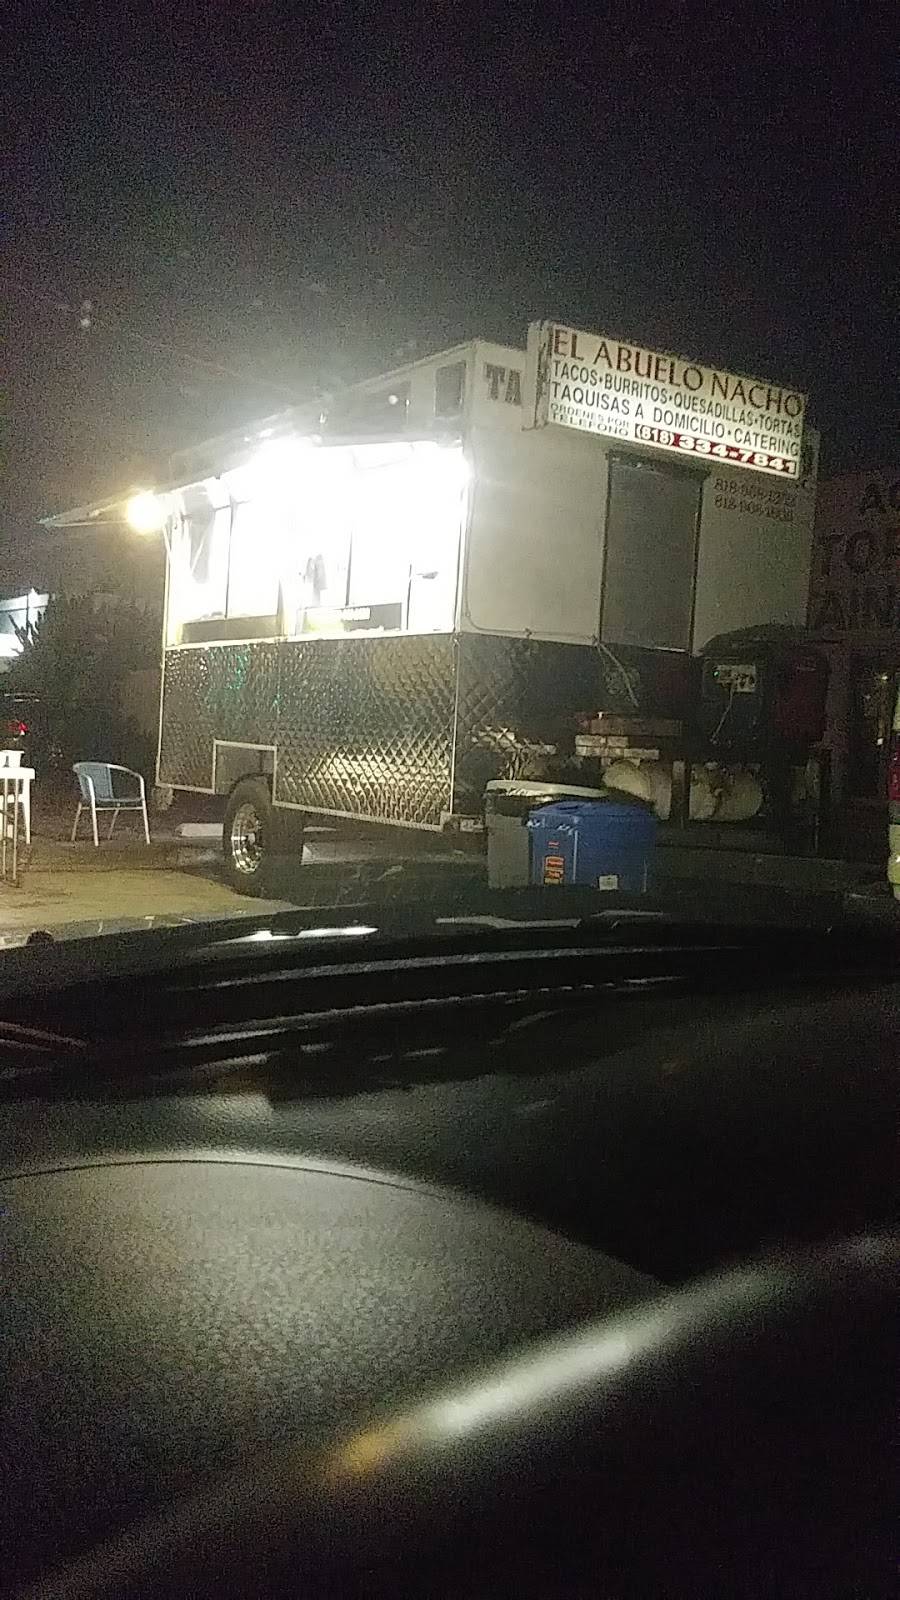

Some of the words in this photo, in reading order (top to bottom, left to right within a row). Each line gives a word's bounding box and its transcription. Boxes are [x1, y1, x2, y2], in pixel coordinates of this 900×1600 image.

[552, 328, 585, 361] EL
[593, 340, 703, 391] ABUELO
[711, 372, 801, 417] NACHO
[553, 360, 598, 386] TACOS
[604, 373, 668, 404] BURRITOS
[674, 392, 754, 427] QUESADILLAS
[759, 414, 800, 438] TORTAS
[551, 381, 630, 415] TAQUISAS
[634, 402, 645, 419] A
[653, 407, 726, 438] DOMICILIO
[734, 428, 800, 457] CATERING
[635, 424, 674, 446] (818)
[679, 435, 797, 473] 334-7841
